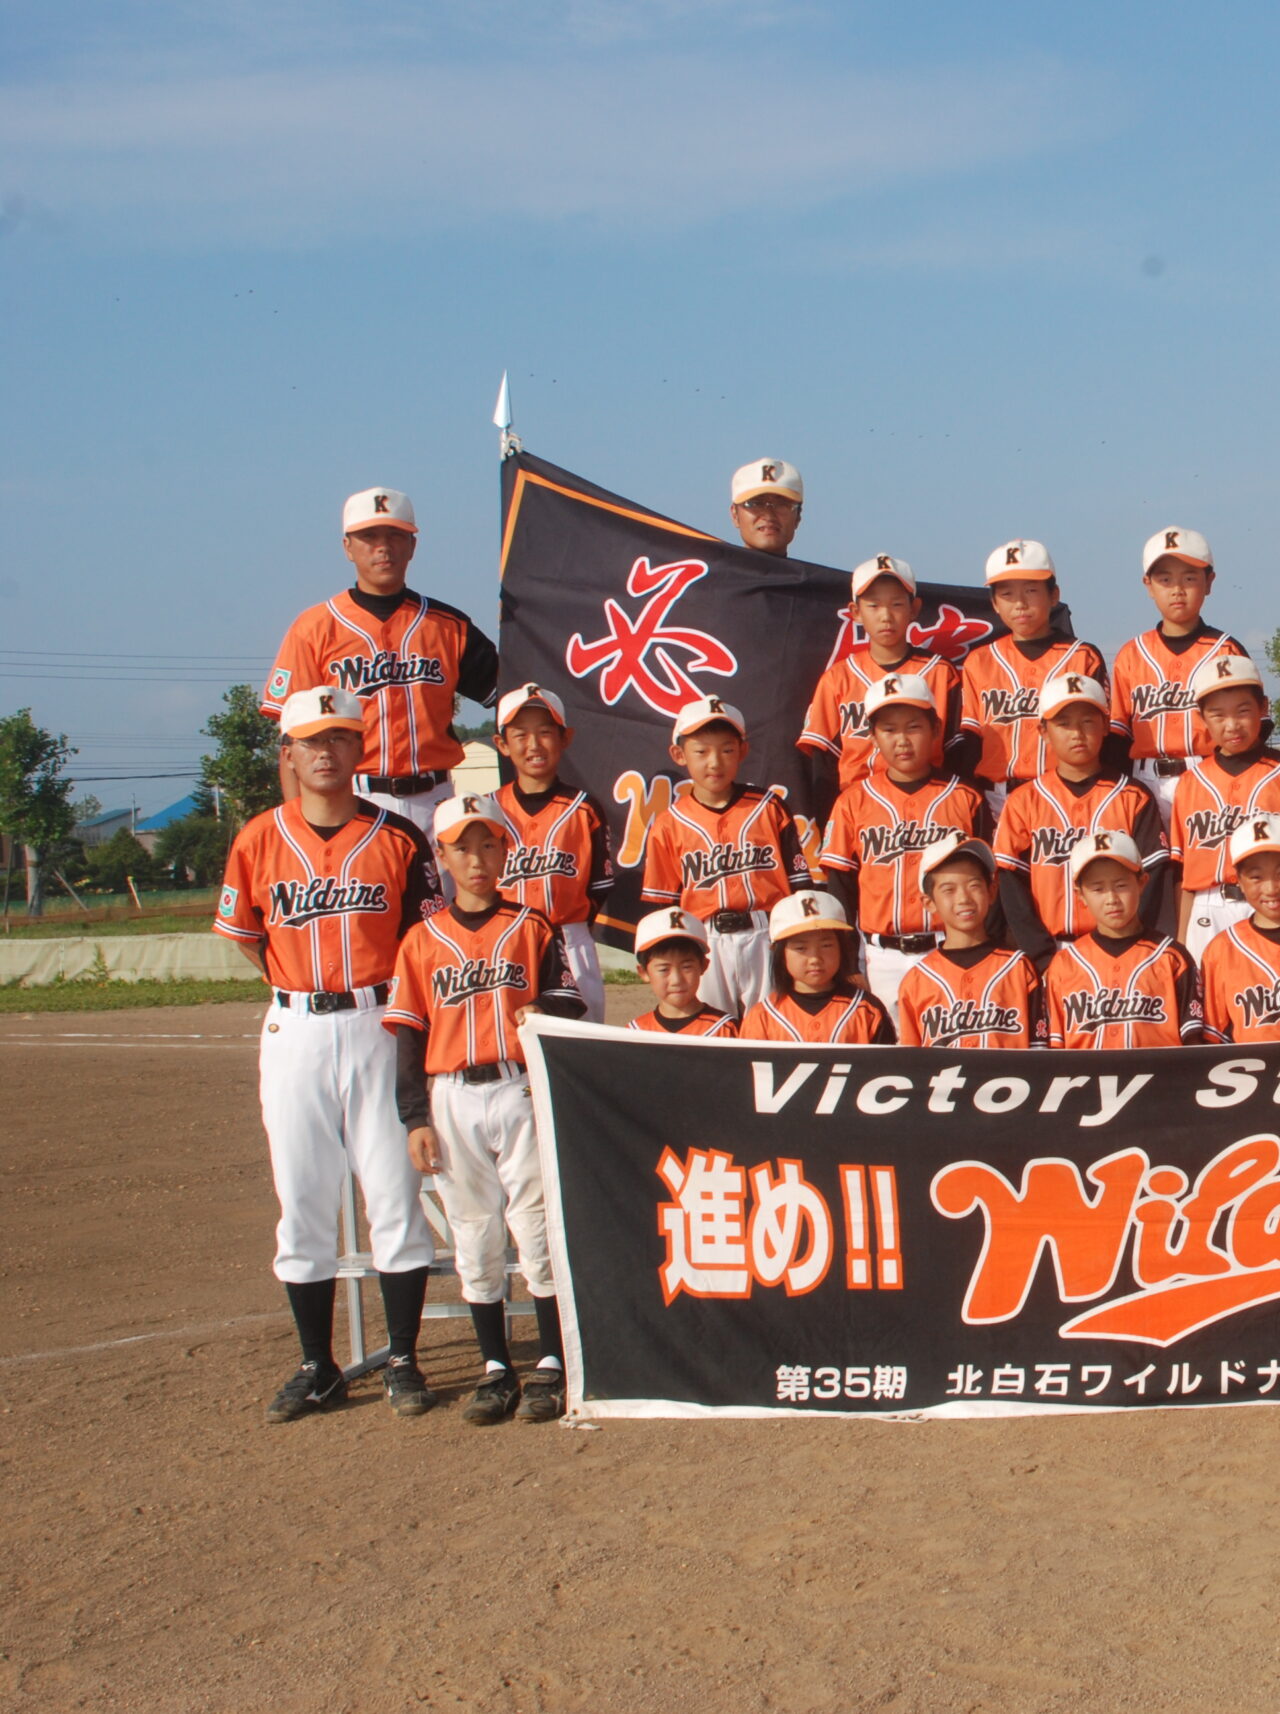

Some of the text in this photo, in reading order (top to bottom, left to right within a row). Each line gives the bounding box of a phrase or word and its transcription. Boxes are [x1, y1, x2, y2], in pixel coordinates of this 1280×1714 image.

[762, 465, 777, 483] K
[374, 494, 390, 514] K
[1165, 531, 1180, 550] K
[877, 555, 892, 571] K
[1006, 547, 1021, 566] K
[330, 650, 444, 698] Wildnine
[1216, 659, 1233, 679] K
[526, 685, 541, 698] K
[884, 678, 898, 697] K
[1067, 676, 1083, 695] K
[319, 694, 337, 716] K
[709, 698, 726, 714] K
[982, 687, 1039, 724] Wild
[1131, 681, 1196, 720] Wildni
[462, 796, 481, 815] K
[1253, 821, 1270, 842] K
[859, 821, 960, 864] Wildnin
[1031, 826, 1086, 865] Wild
[1094, 833, 1111, 852] K
[498, 847, 577, 888] ildnine
[682, 842, 777, 890] Wildnine
[270, 878, 388, 929] Wildnine
[801, 897, 820, 918] K
[669, 911, 687, 931] K
[433, 959, 527, 1007] Wildnine
[1063, 988, 1165, 1032] Wildnine
[922, 1000, 1022, 1047] Wildnine
[751, 1061, 1155, 1127] Victory
[655, 1145, 903, 1308] 進め!!
[775, 1364, 907, 1401] 第35期
